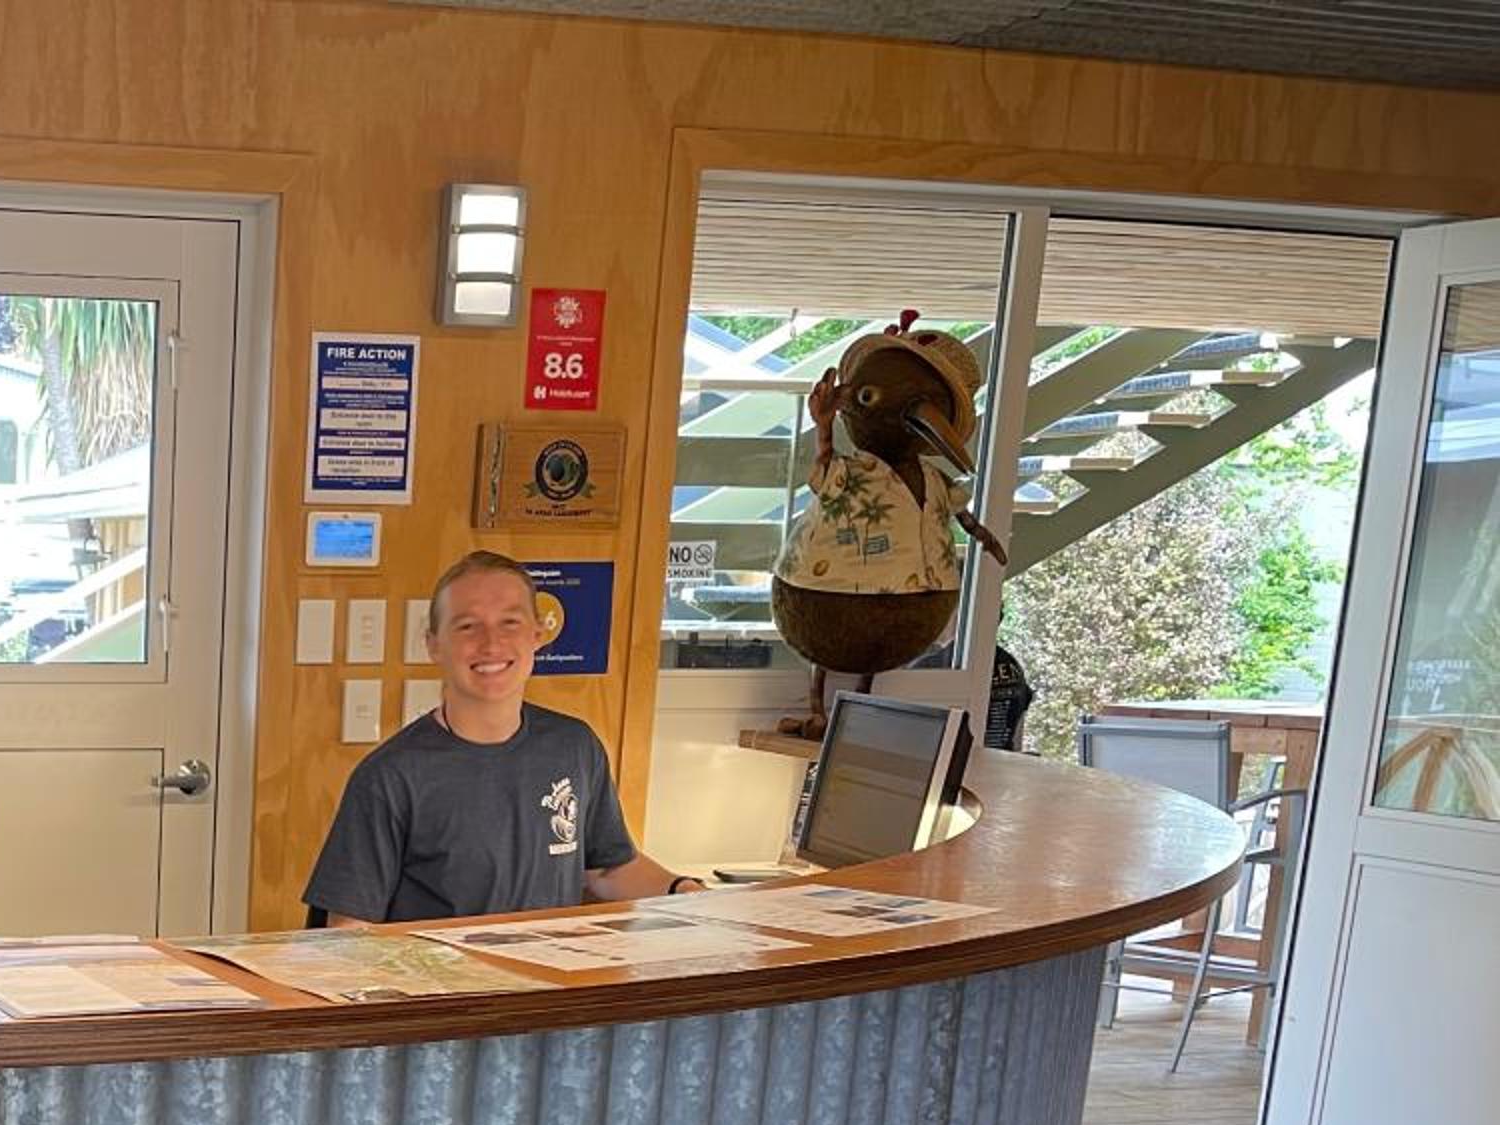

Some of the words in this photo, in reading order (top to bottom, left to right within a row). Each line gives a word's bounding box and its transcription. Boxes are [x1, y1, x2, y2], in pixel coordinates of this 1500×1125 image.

[327, 347, 356, 359] FIRE
[358, 347, 406, 360] ACTION
[544, 352, 583, 379] 8.6
[669, 546, 691, 562] NO
